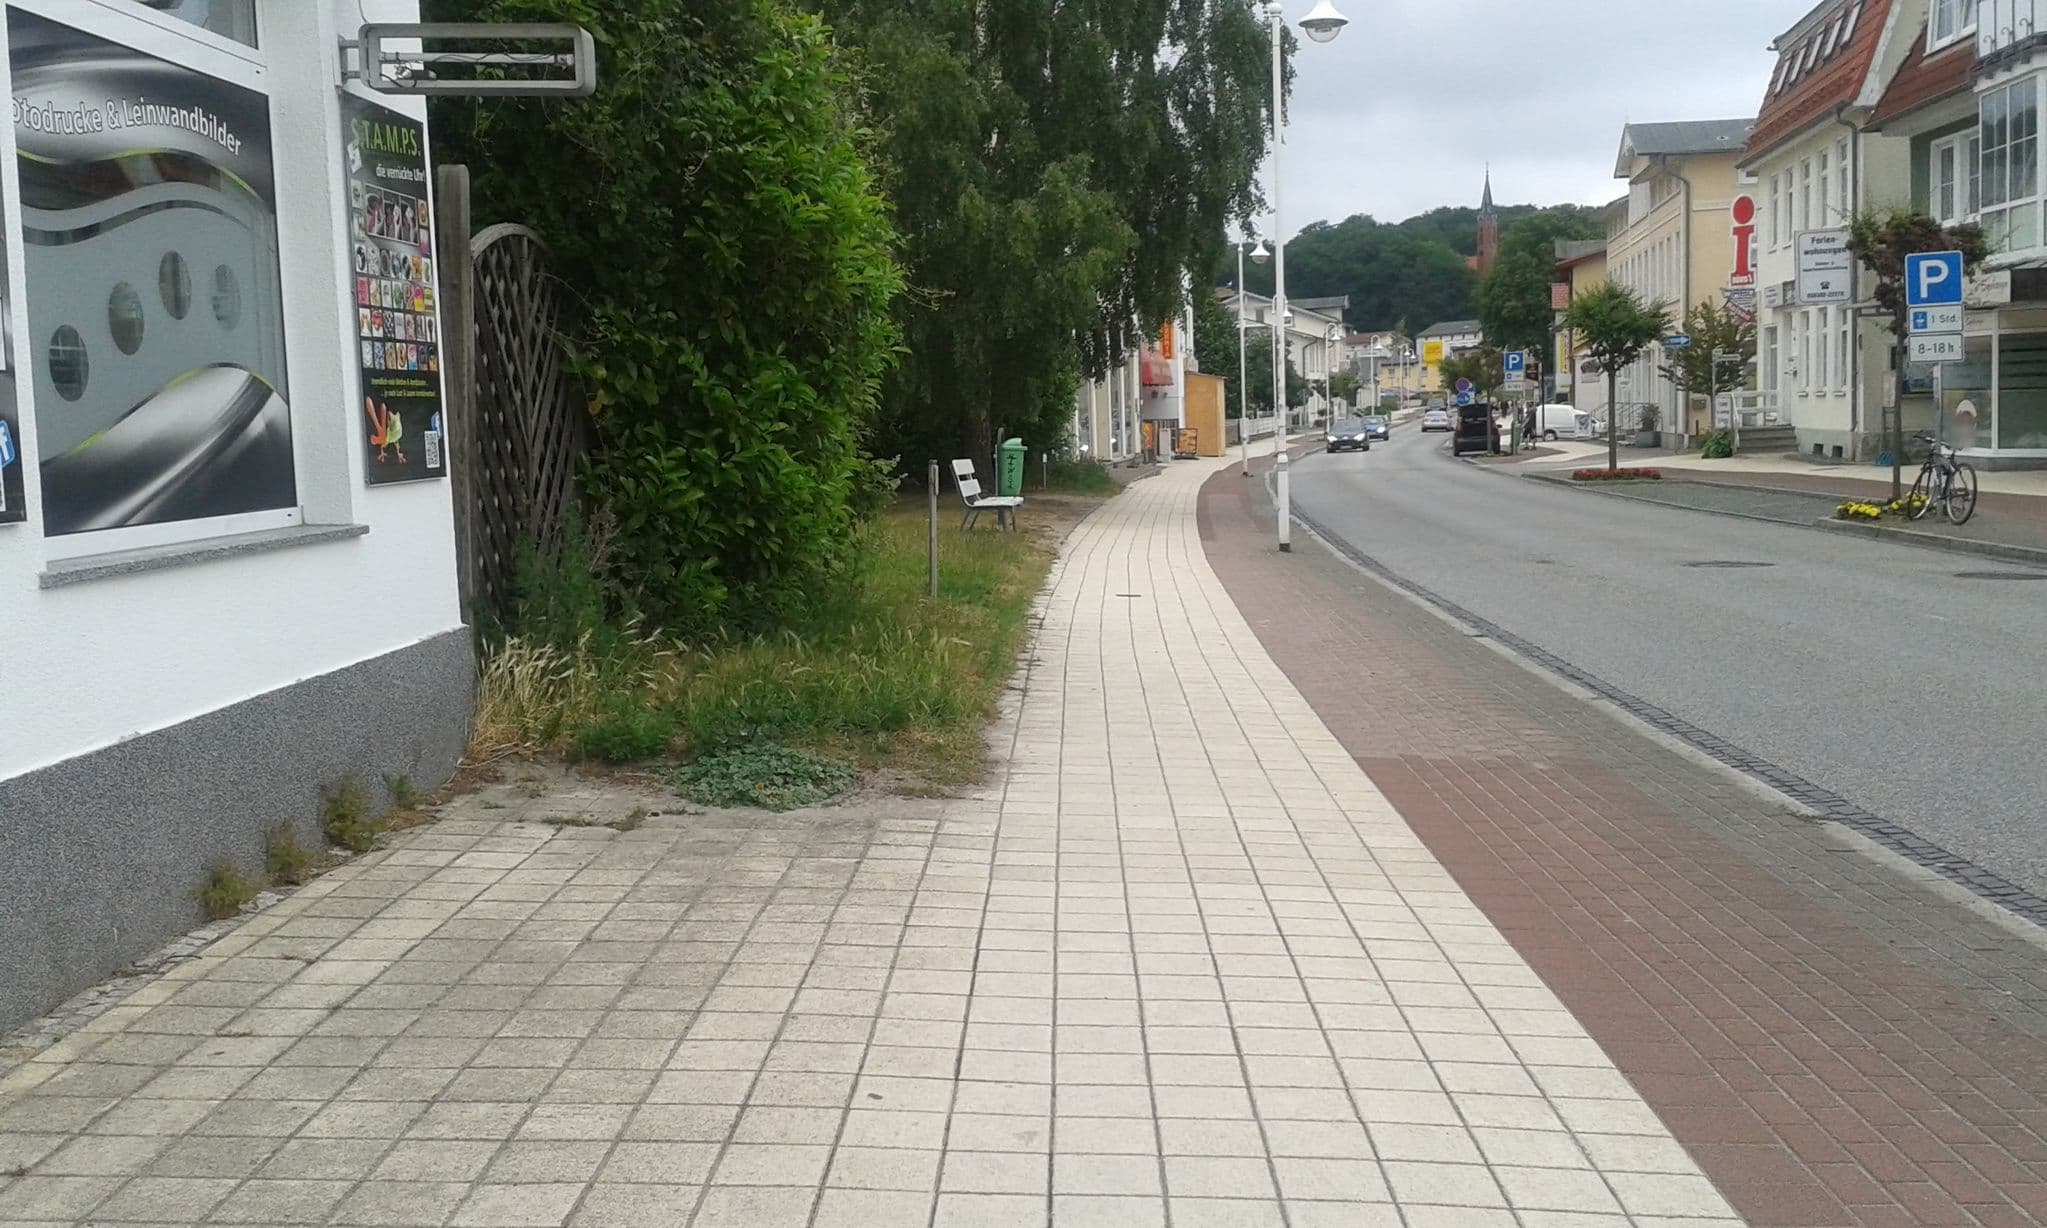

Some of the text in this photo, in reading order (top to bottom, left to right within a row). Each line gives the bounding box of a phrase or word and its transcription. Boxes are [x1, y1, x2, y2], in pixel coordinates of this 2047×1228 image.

[106, 99, 122, 129] &
[122, 97, 242, 156] Leinwandbilder
[351, 118, 421, 156] S.T.A.M.P.S.
[375, 163, 386, 178] die
[1919, 259, 1949, 298] P
[1508, 354, 1520, 369] P
